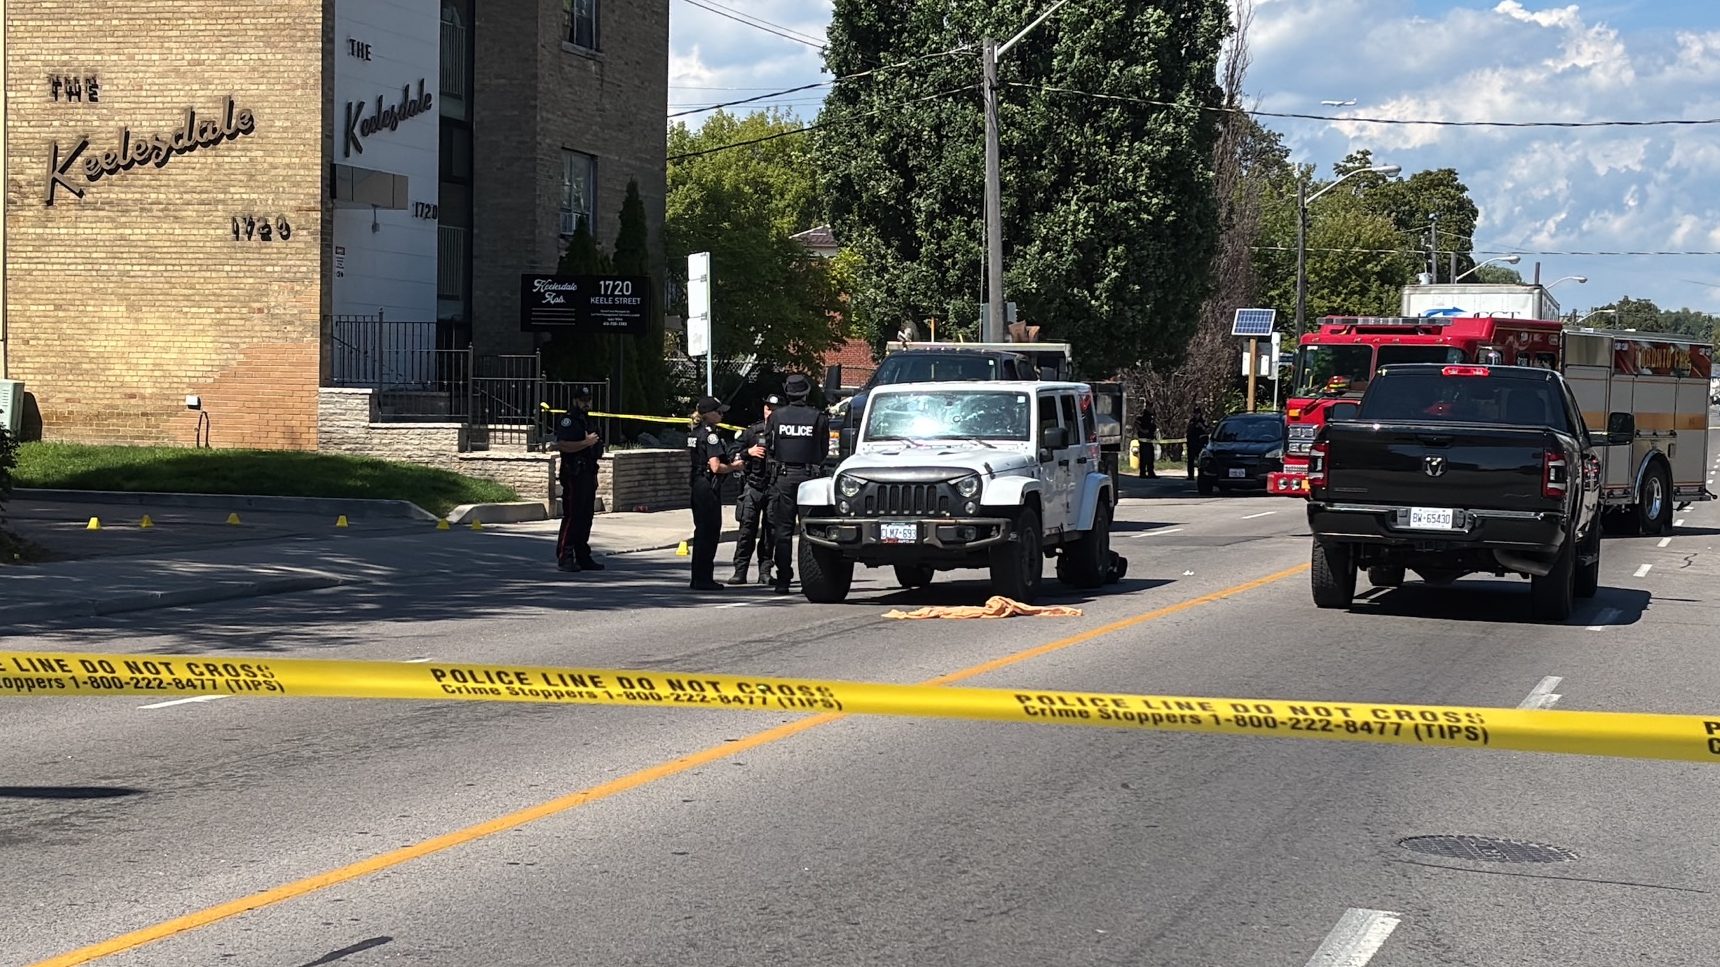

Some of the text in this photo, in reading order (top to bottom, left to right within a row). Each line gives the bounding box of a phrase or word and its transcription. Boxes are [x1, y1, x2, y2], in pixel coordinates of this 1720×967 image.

[347, 37, 372, 62] THE
[49, 74, 99, 101] THE
[344, 78, 432, 158] Keelesdale
[44, 95, 255, 206] Keelesdale
[414, 201, 438, 220] 1720
[231, 214, 292, 241] 1720
[532, 279, 577, 292] Keelesdale
[599, 280, 632, 295] 1720
[590, 297, 641, 305] KEELE STREET
[779, 425, 813, 437] POLICE
[12, 657, 73, 673] LINE
[78, 660, 117, 675] DO
[123, 661, 179, 677] NOT
[186, 662, 275, 680] CROSS
[70, 676, 218, 690] 1-800-222-8477
[224, 678, 285, 693] (TIPS)
[430, 668, 835, 699] POLICE LINE DO NOT CROSS
[441, 683, 843, 712] Crime Stoppers 1-800-222-8477 (TIPS)
[1013, 694, 1486, 725] POLICE LINE DO NOT CROSS
[1023, 705, 1489, 744] Crime Stoppers 1-800-222-8477 (TIPS)
